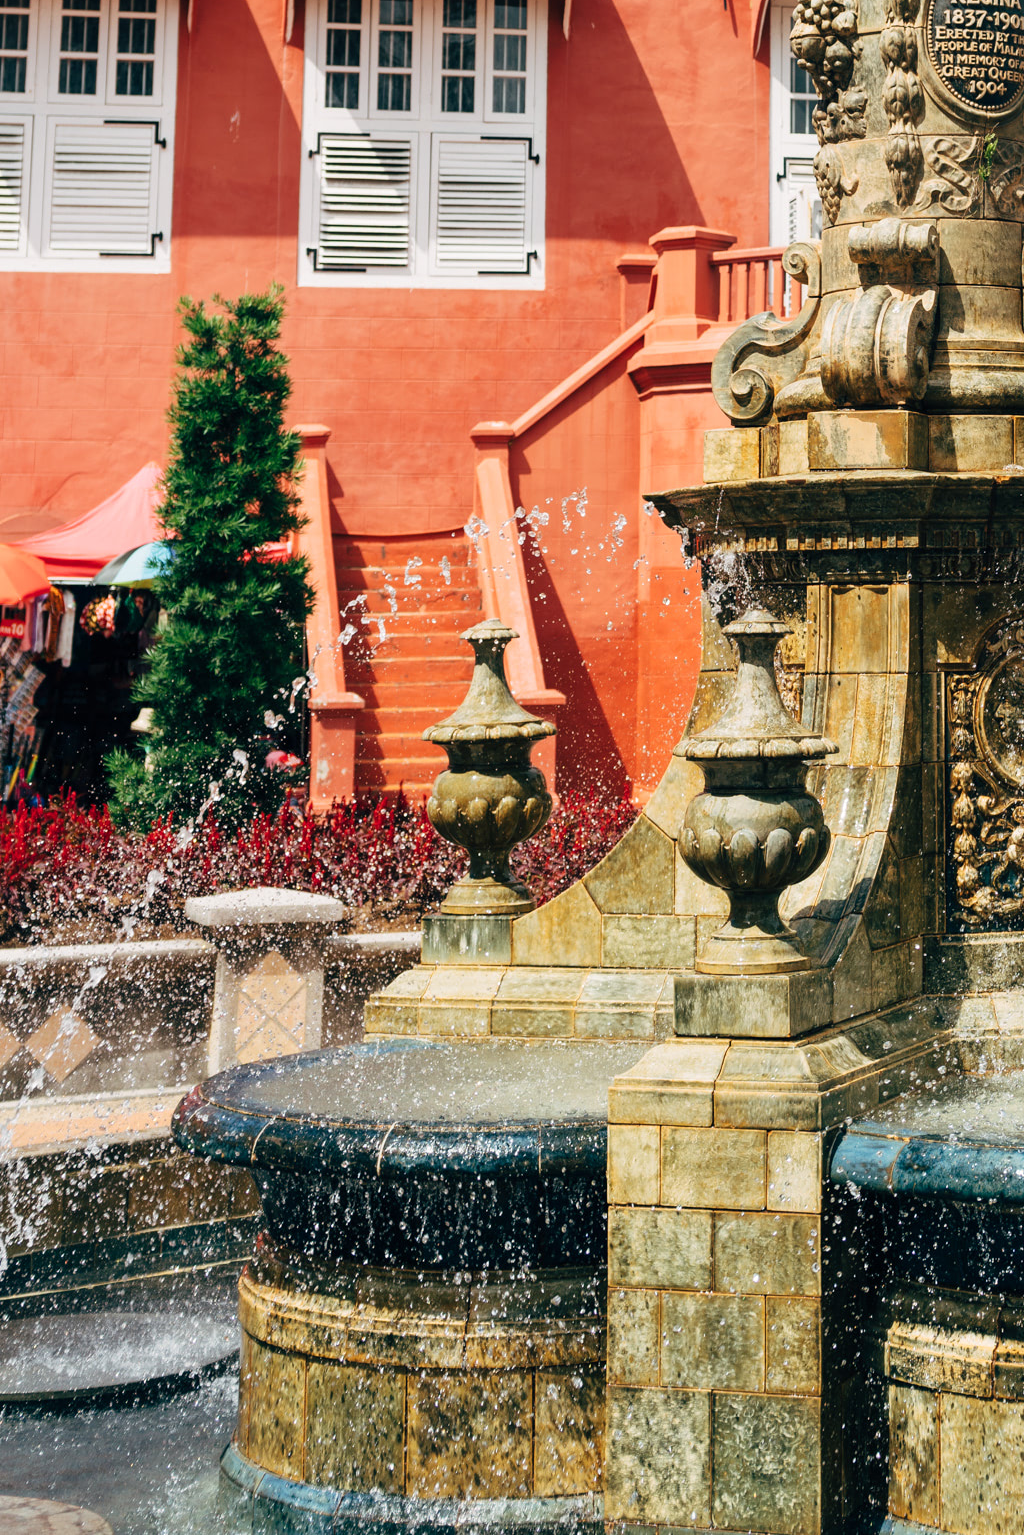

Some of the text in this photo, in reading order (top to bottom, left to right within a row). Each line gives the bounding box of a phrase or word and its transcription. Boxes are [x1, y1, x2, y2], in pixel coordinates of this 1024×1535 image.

[943, 9, 1024, 31] 1837-1901
[935, 25, 995, 40] ERECTED
[995, 31, 1010, 43] BY
[934, 41, 978, 51] PEOPLE
[979, 42, 993, 53] OF
[940, 53, 954, 64] IN
[956, 53, 1007, 67] MEMORY
[1008, 58, 1020, 69] OF
[942, 64, 988, 80] GREAT
[969, 79, 1008, 101] 1904
